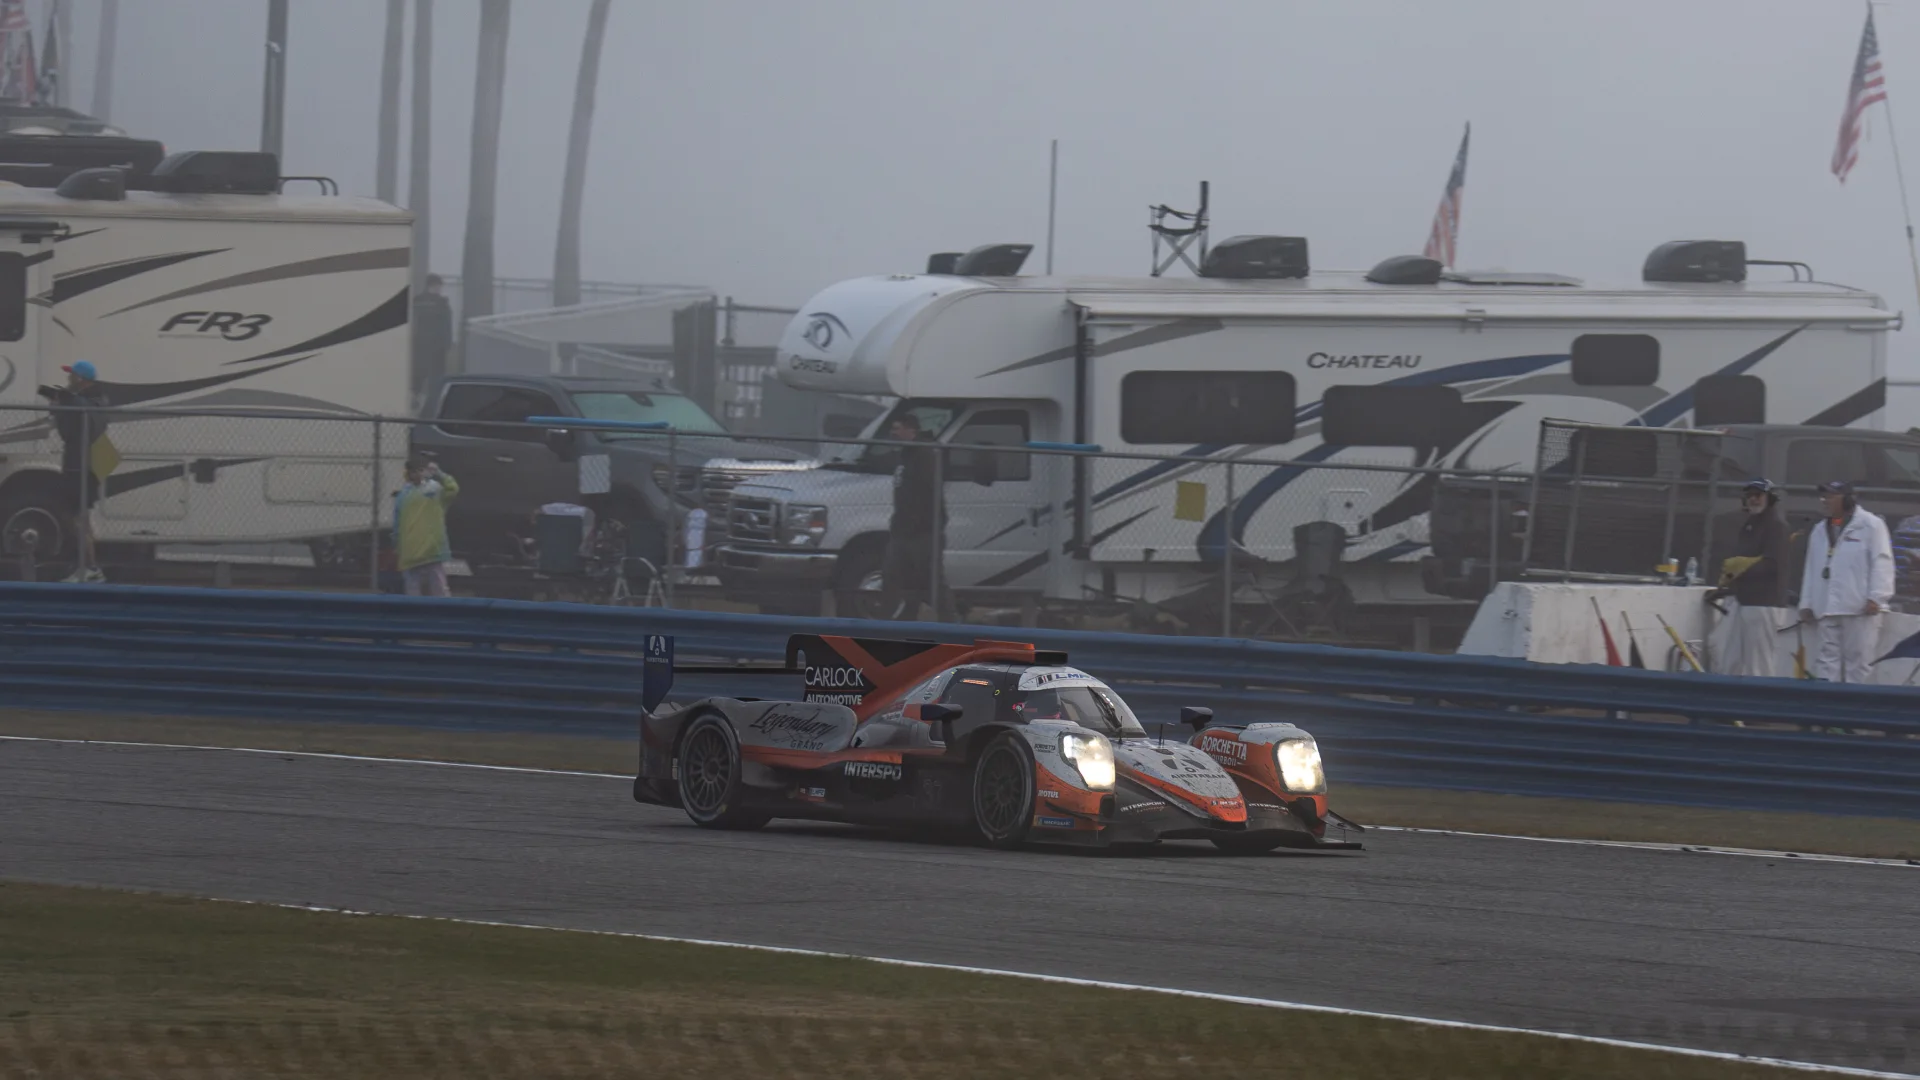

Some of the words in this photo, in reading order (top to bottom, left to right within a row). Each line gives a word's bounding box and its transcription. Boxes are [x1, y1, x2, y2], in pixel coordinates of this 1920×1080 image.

[159, 311, 273, 341] FR3
[1306, 351, 1422, 369] CHATEAU
[805, 666, 864, 687] CARLOCK
[806, 693, 862, 705] AUTOMOTIVE
[749, 703, 838, 742] Legendary
[790, 739, 823, 750] GRAND
[1201, 735, 1247, 761] BORCHETTA
[844, 761, 902, 781] INTERSPO
